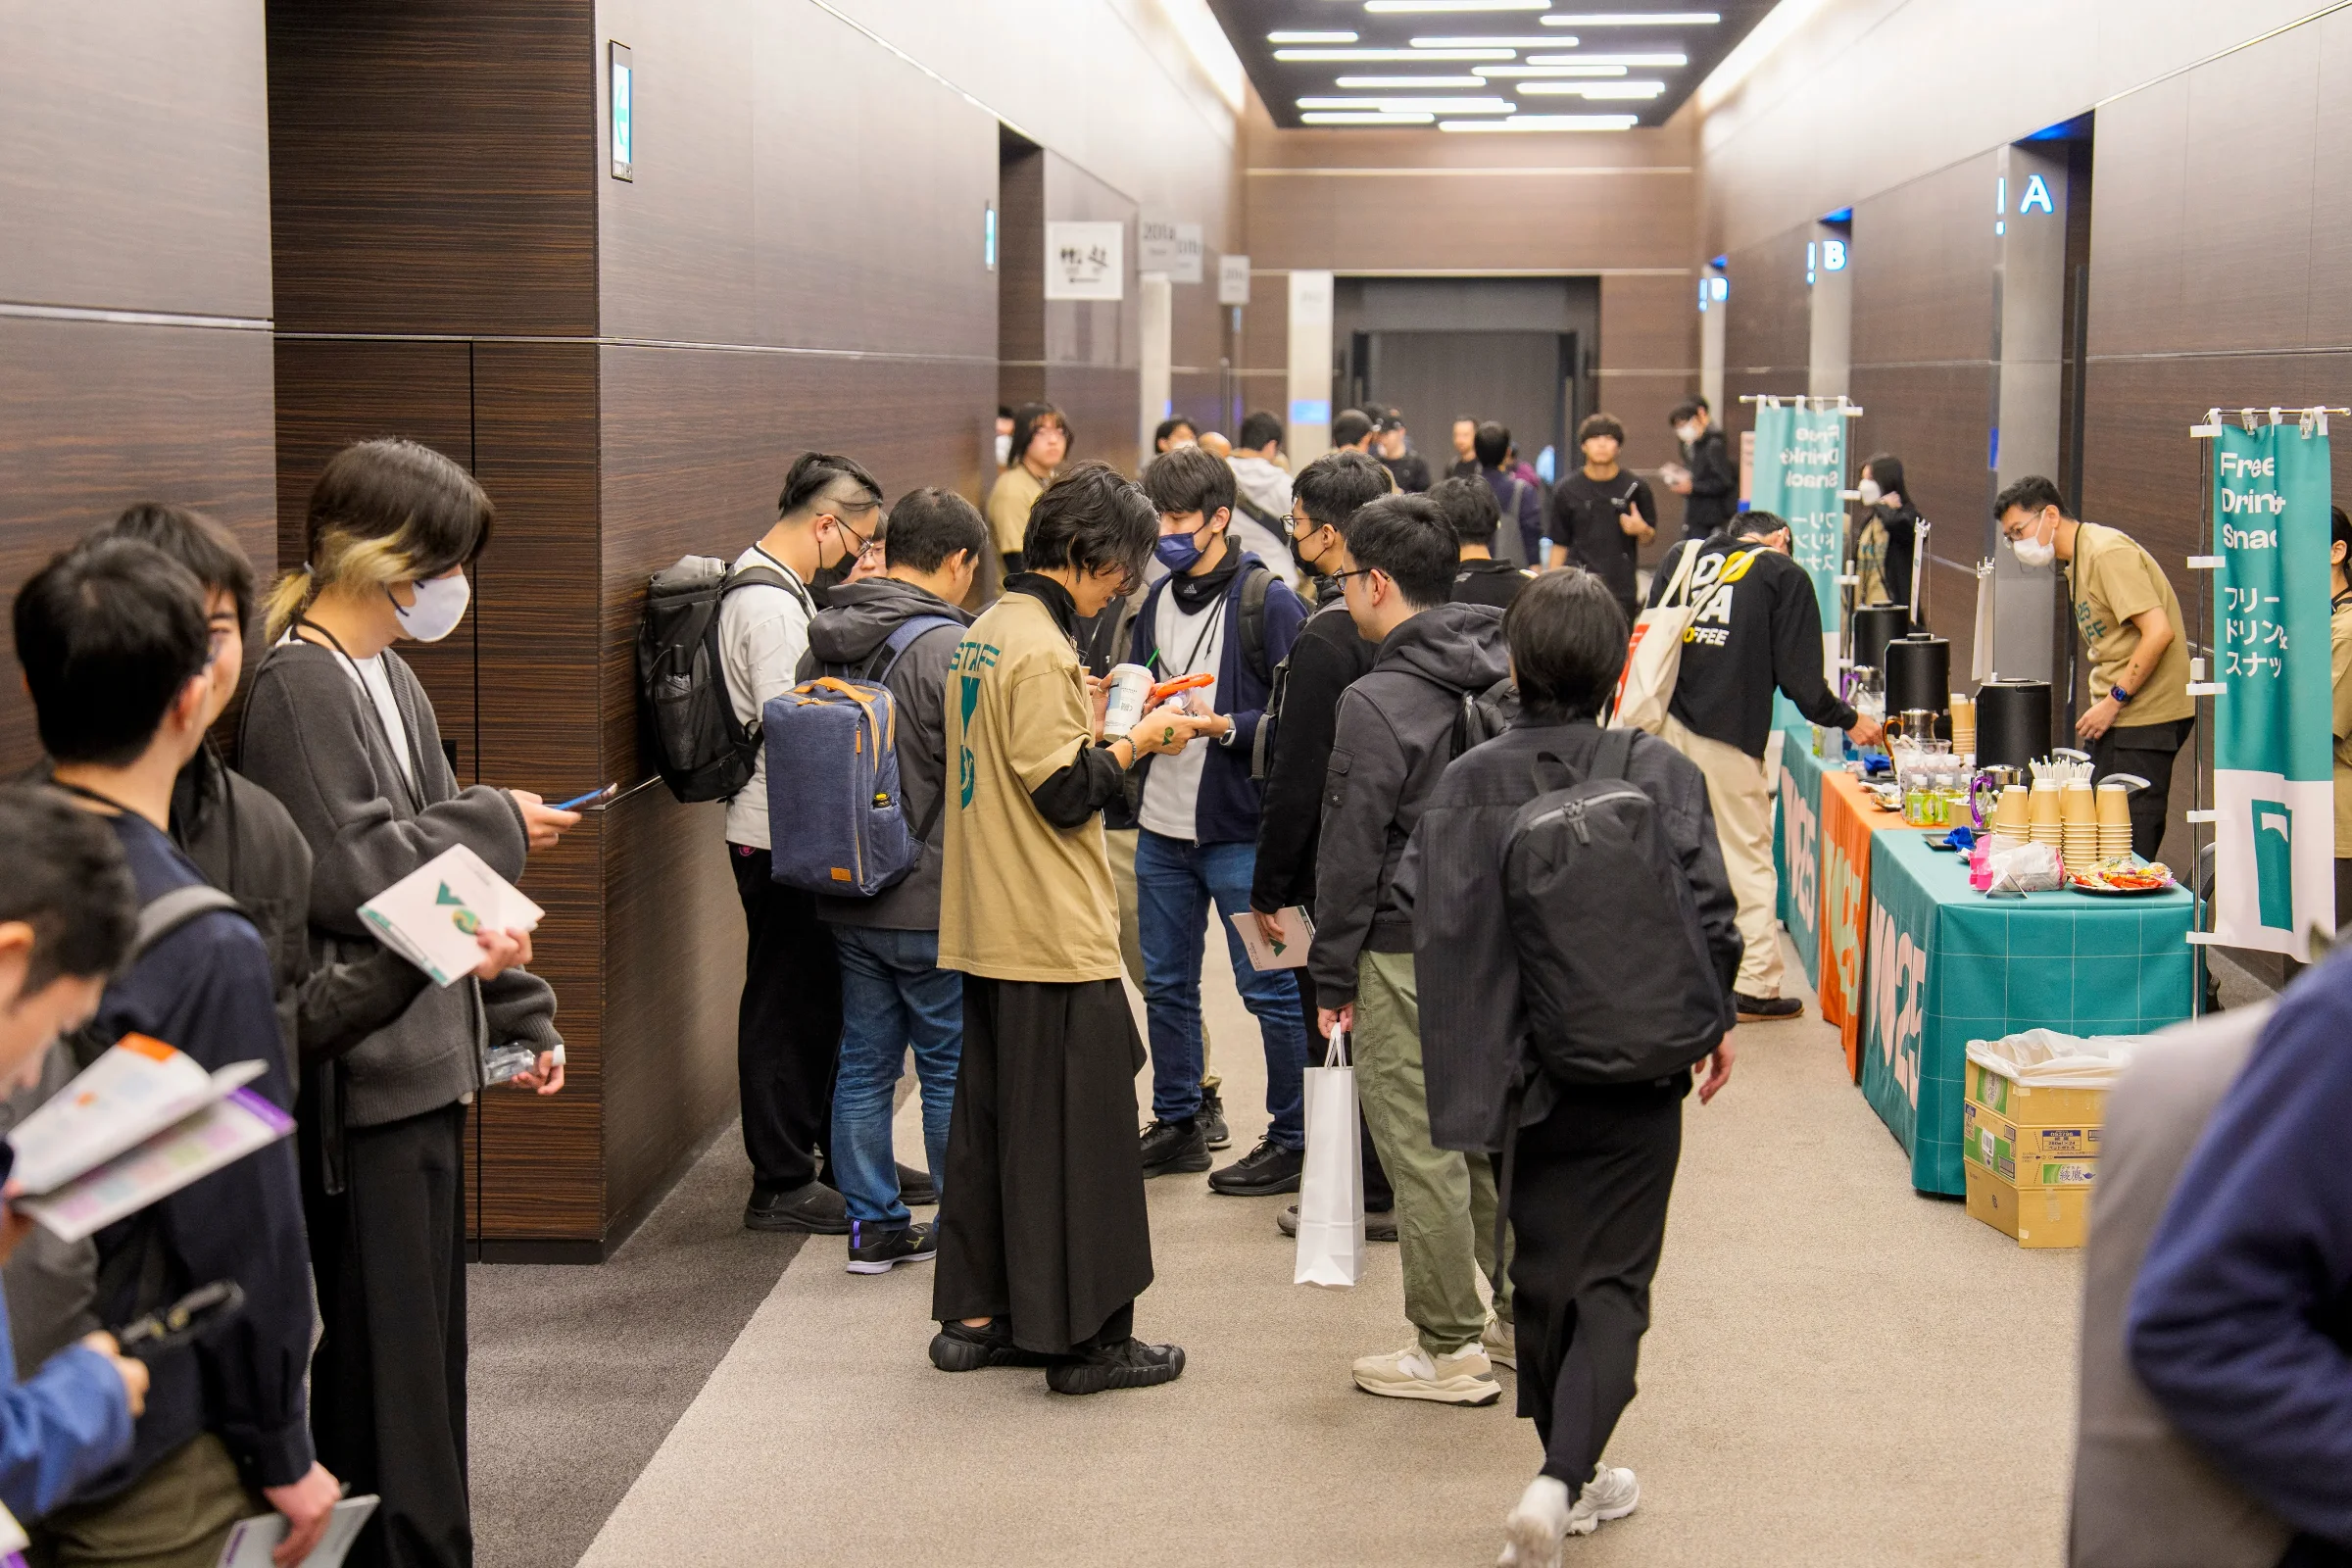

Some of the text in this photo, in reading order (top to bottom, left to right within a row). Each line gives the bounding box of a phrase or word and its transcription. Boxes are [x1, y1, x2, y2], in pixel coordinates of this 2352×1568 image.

[2020, 173, 2054, 215] A
[1822, 240, 1846, 271] B
[2220, 452, 2275, 478] Free
[2223, 522, 2278, 550] Snac
[2224, 587, 2280, 613] フリー
[1683, 626, 1730, 647] OFFEE
